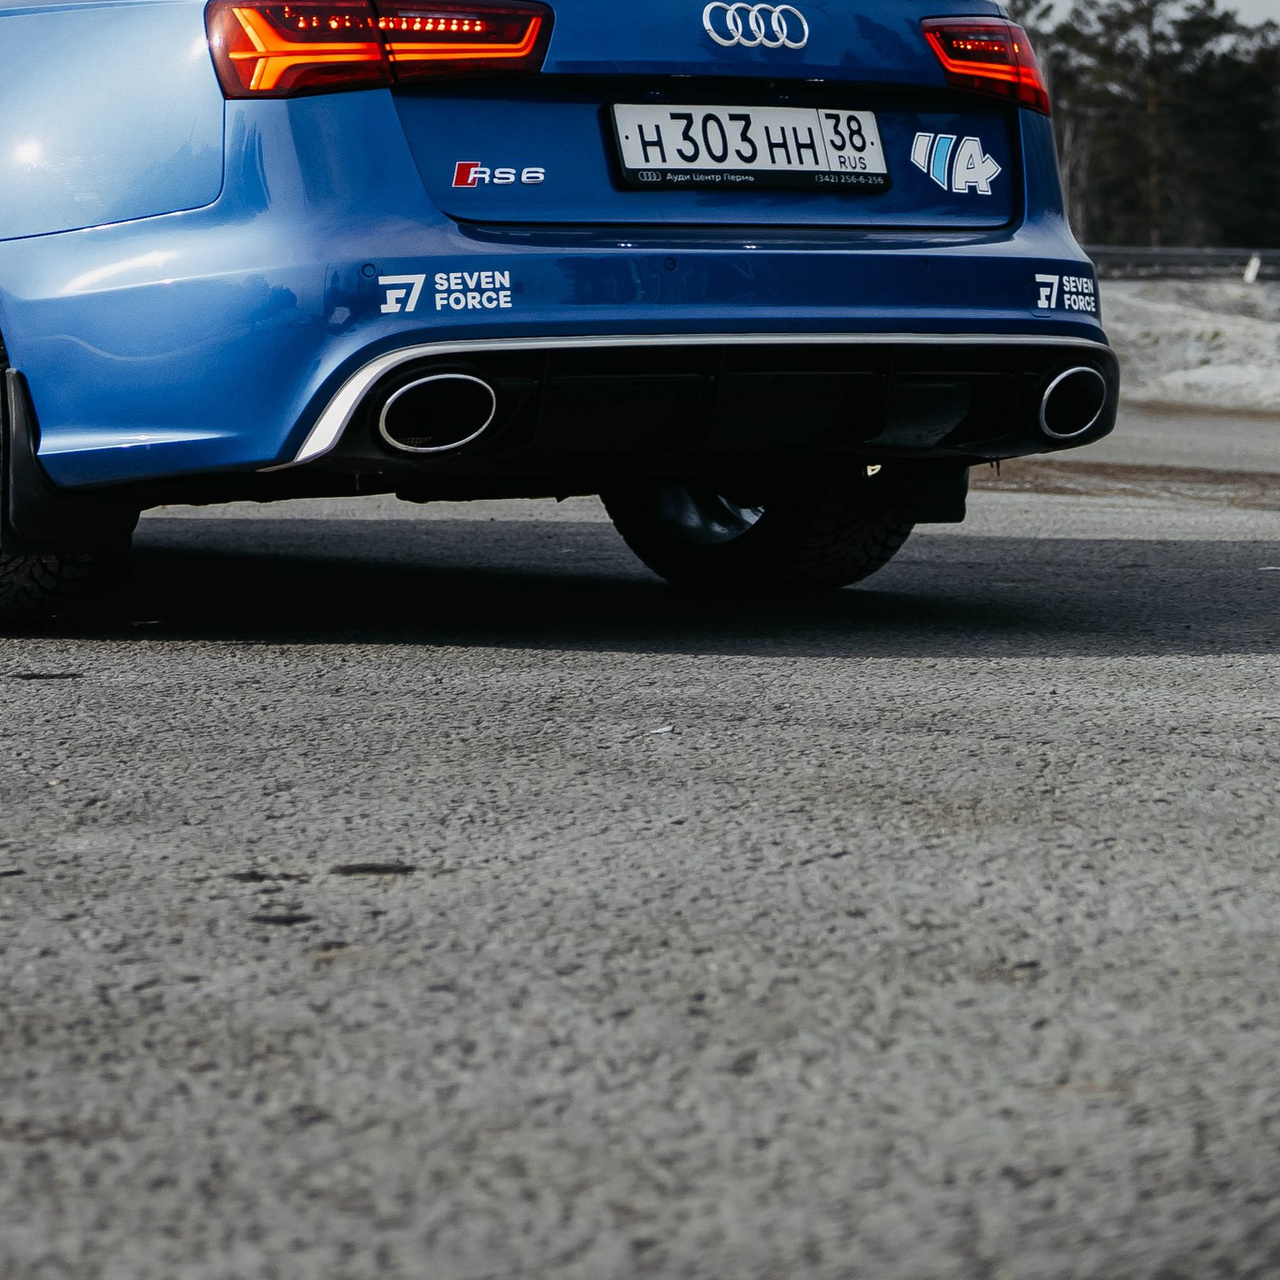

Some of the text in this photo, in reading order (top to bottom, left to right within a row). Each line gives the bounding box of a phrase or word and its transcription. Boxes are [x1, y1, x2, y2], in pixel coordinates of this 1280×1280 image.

[824, 112, 868, 153] 38
[838, 155, 868, 171] RUS
[467, 166, 546, 185] RS6
[666, 173, 755, 183] Ауди Центр Пермь
[815, 174, 885, 185] (342) 256-6-256
[434, 271, 511, 290] SEVEN
[1062, 275, 1094, 294] SEVEN
[435, 291, 513, 310] FORCE
[1063, 294, 1096, 312] FORCE
